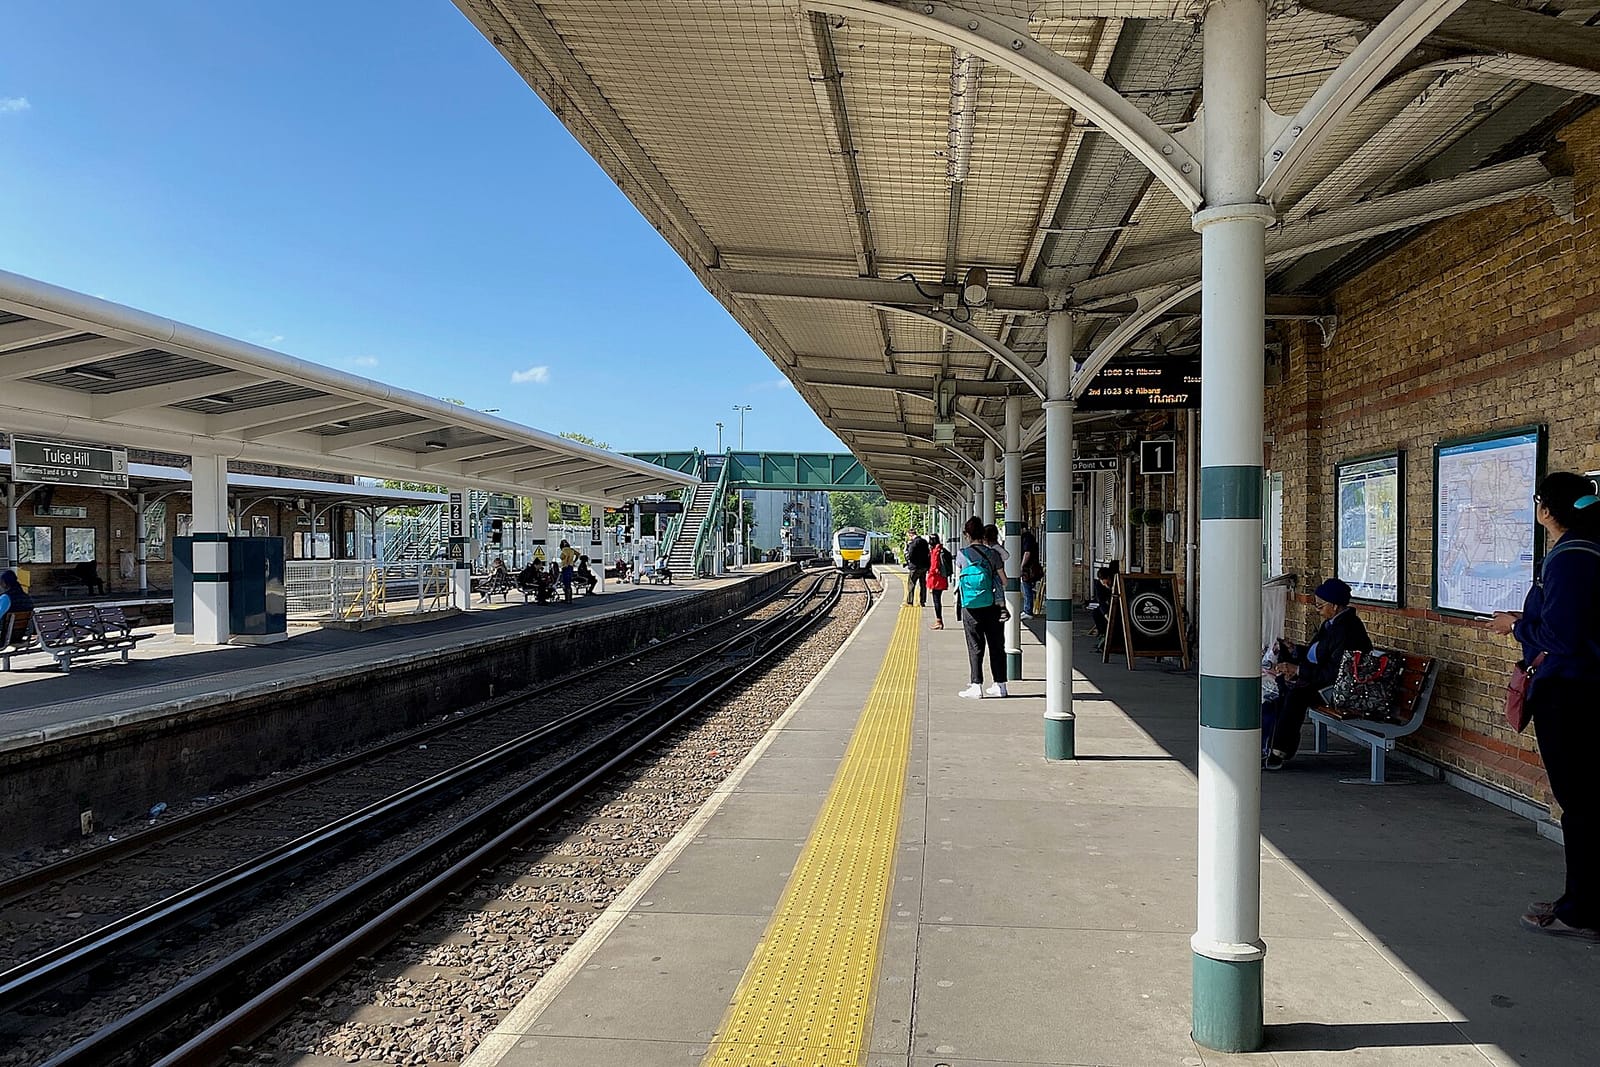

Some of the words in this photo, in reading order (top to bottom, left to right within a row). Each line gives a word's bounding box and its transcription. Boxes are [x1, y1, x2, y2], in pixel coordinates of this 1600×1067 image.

[1088, 388, 1100, 396] 2nd
[1124, 387, 1133, 395] St
[1135, 387, 1161, 395] Albans
[43, 448, 72, 464] Tulse
[73, 451, 90, 466] Hill
[1154, 446, 1162, 468] 1
[117, 460, 123, 471] 3
[1078, 460, 1096, 470] Point
[453, 504, 460, 513] 2
[453, 521, 460, 530] 3
